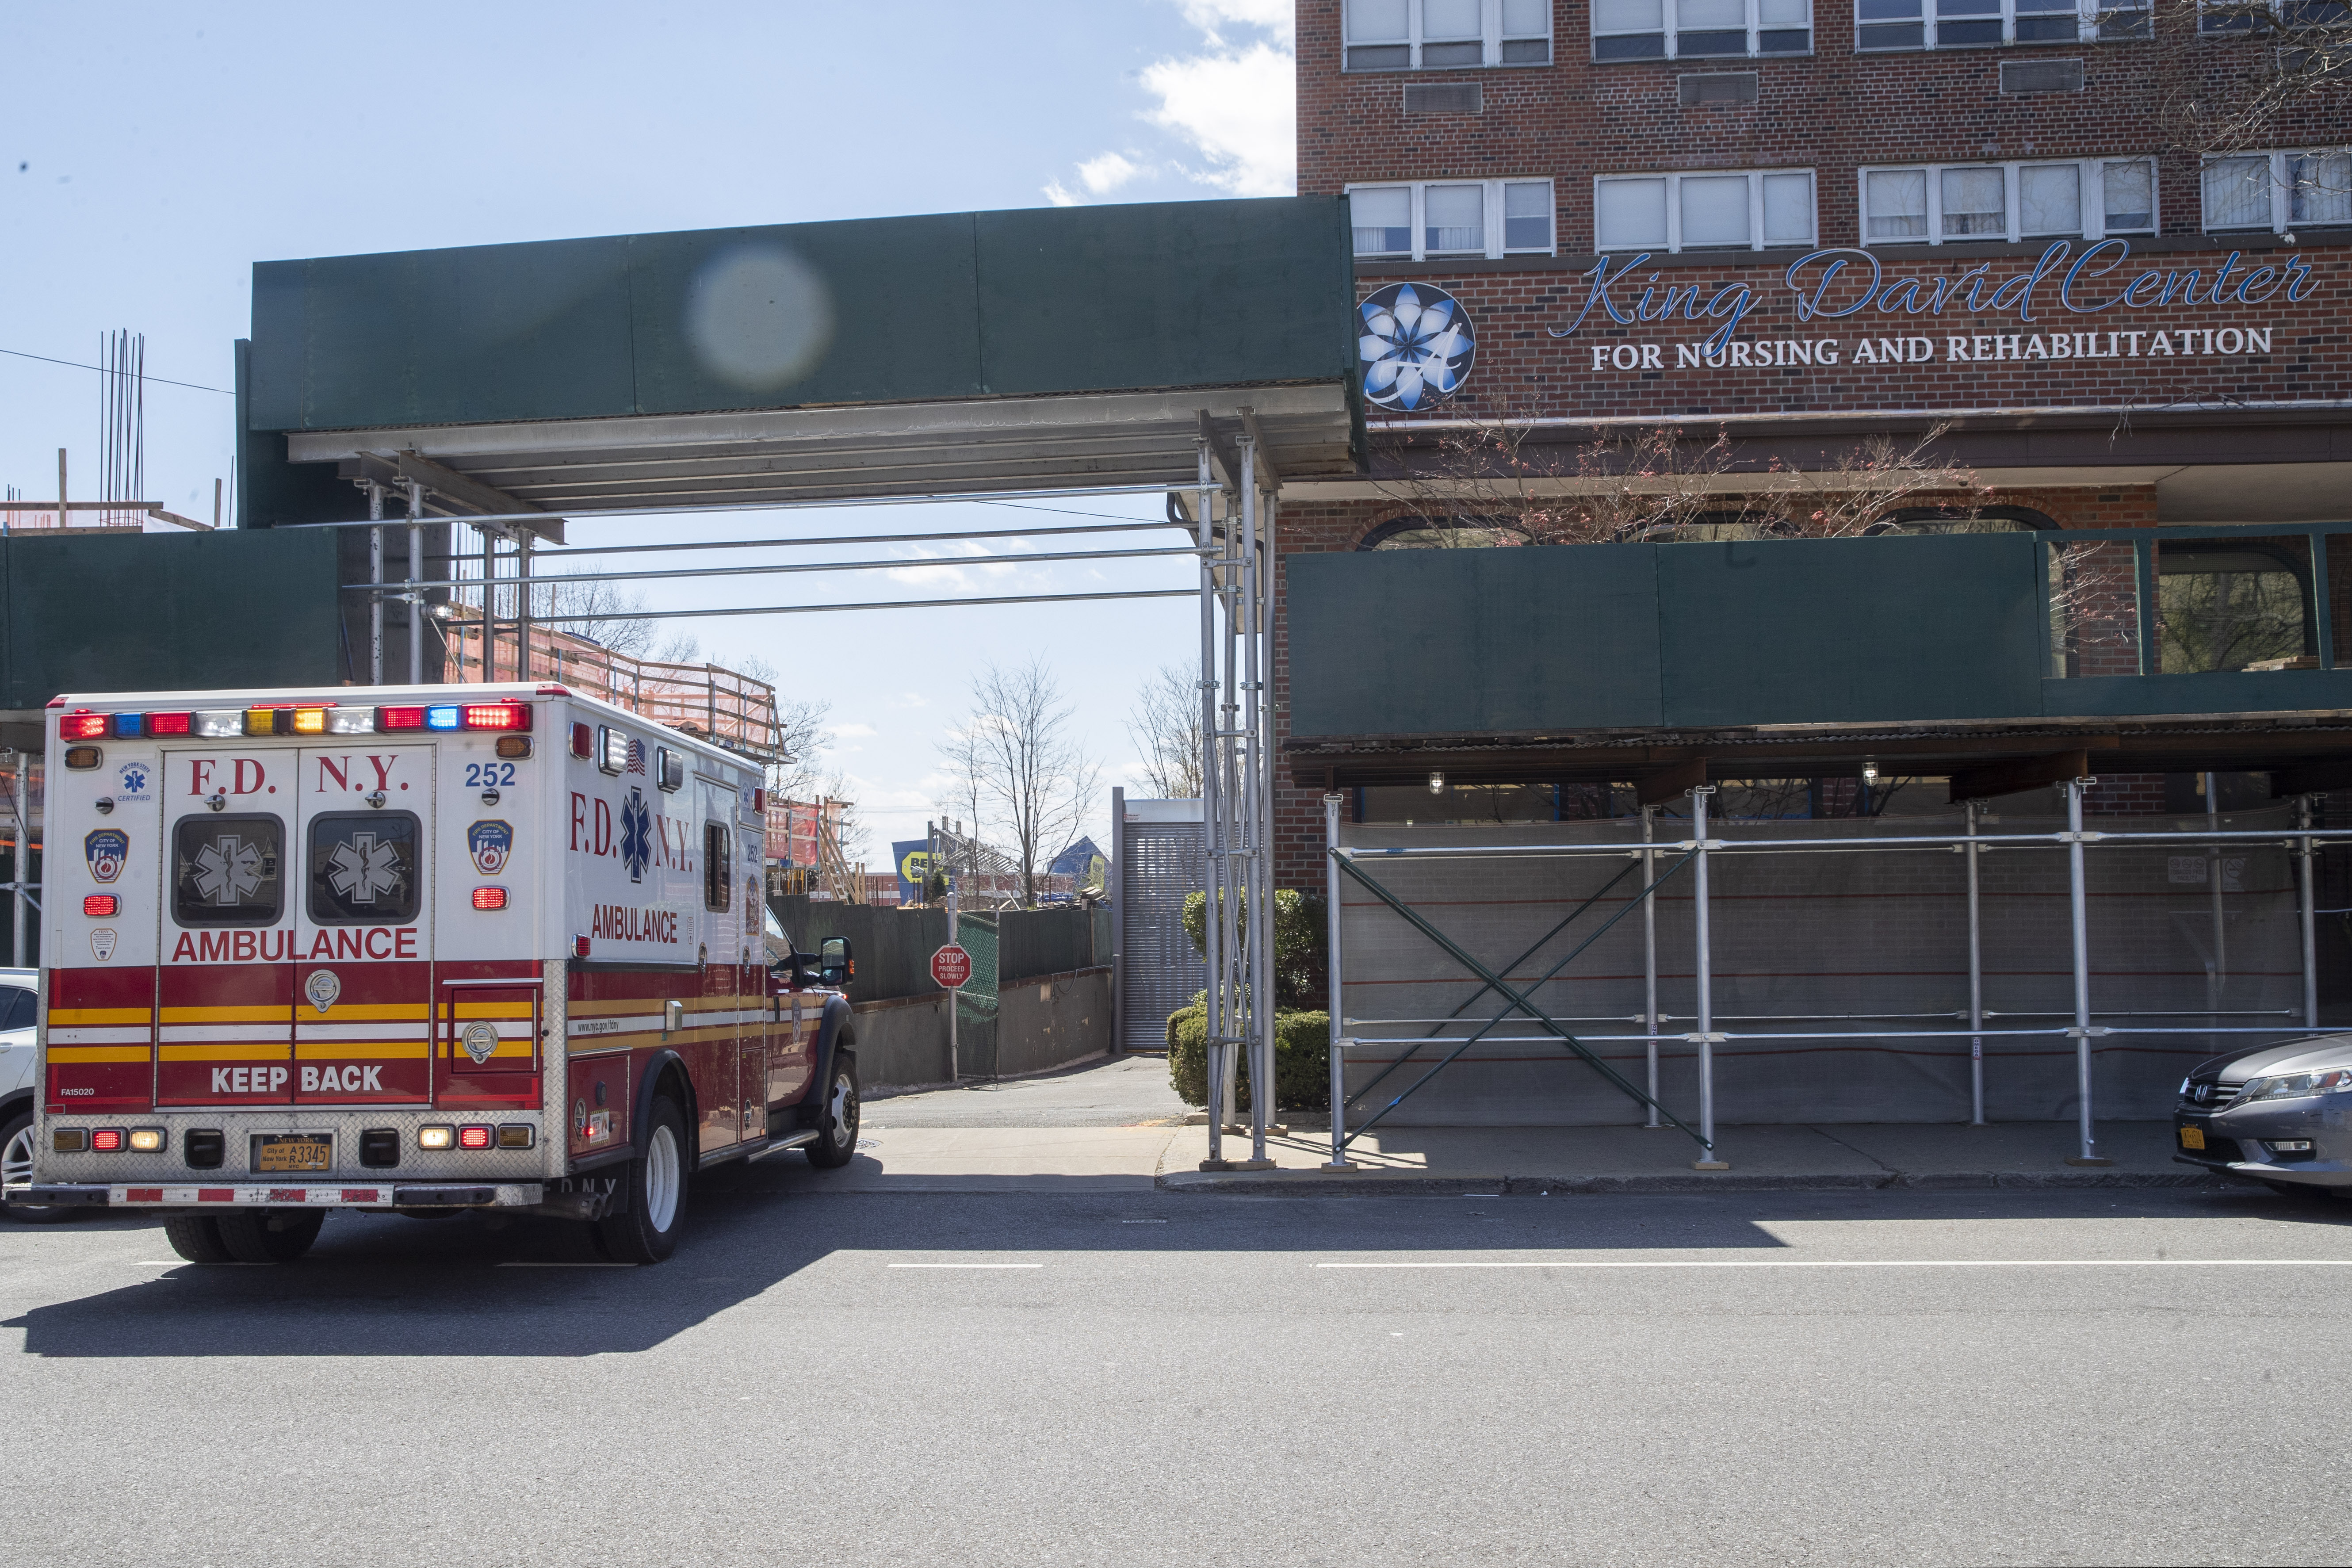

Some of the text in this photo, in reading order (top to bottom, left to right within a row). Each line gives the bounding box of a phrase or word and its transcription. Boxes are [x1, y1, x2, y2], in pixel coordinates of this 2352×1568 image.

[1548, 238, 2321, 358] King David Center
[1591, 327, 2273, 371] FOR NURSING AND REHABILITATION
[119, 765, 127, 774] NEW
[140, 763, 151, 773] STATE
[188, 755, 409, 795] F.D. N.Y.
[465, 762, 515, 787] 252
[89, 832, 125, 845] FIRE DEPARTMENT
[472, 823, 509, 836] FIRE DEPARTMENT
[570, 791, 693, 873] F.D. N.Y.
[747, 844, 757, 863] 252
[591, 904, 677, 944] AMBULANCE
[172, 927, 417, 963] AMBULANCE
[939, 952, 964, 964] STOP
[577, 1019, 619, 1033] www.nyc.gov/fdny
[212, 1065, 383, 1093] KEEP BACK
